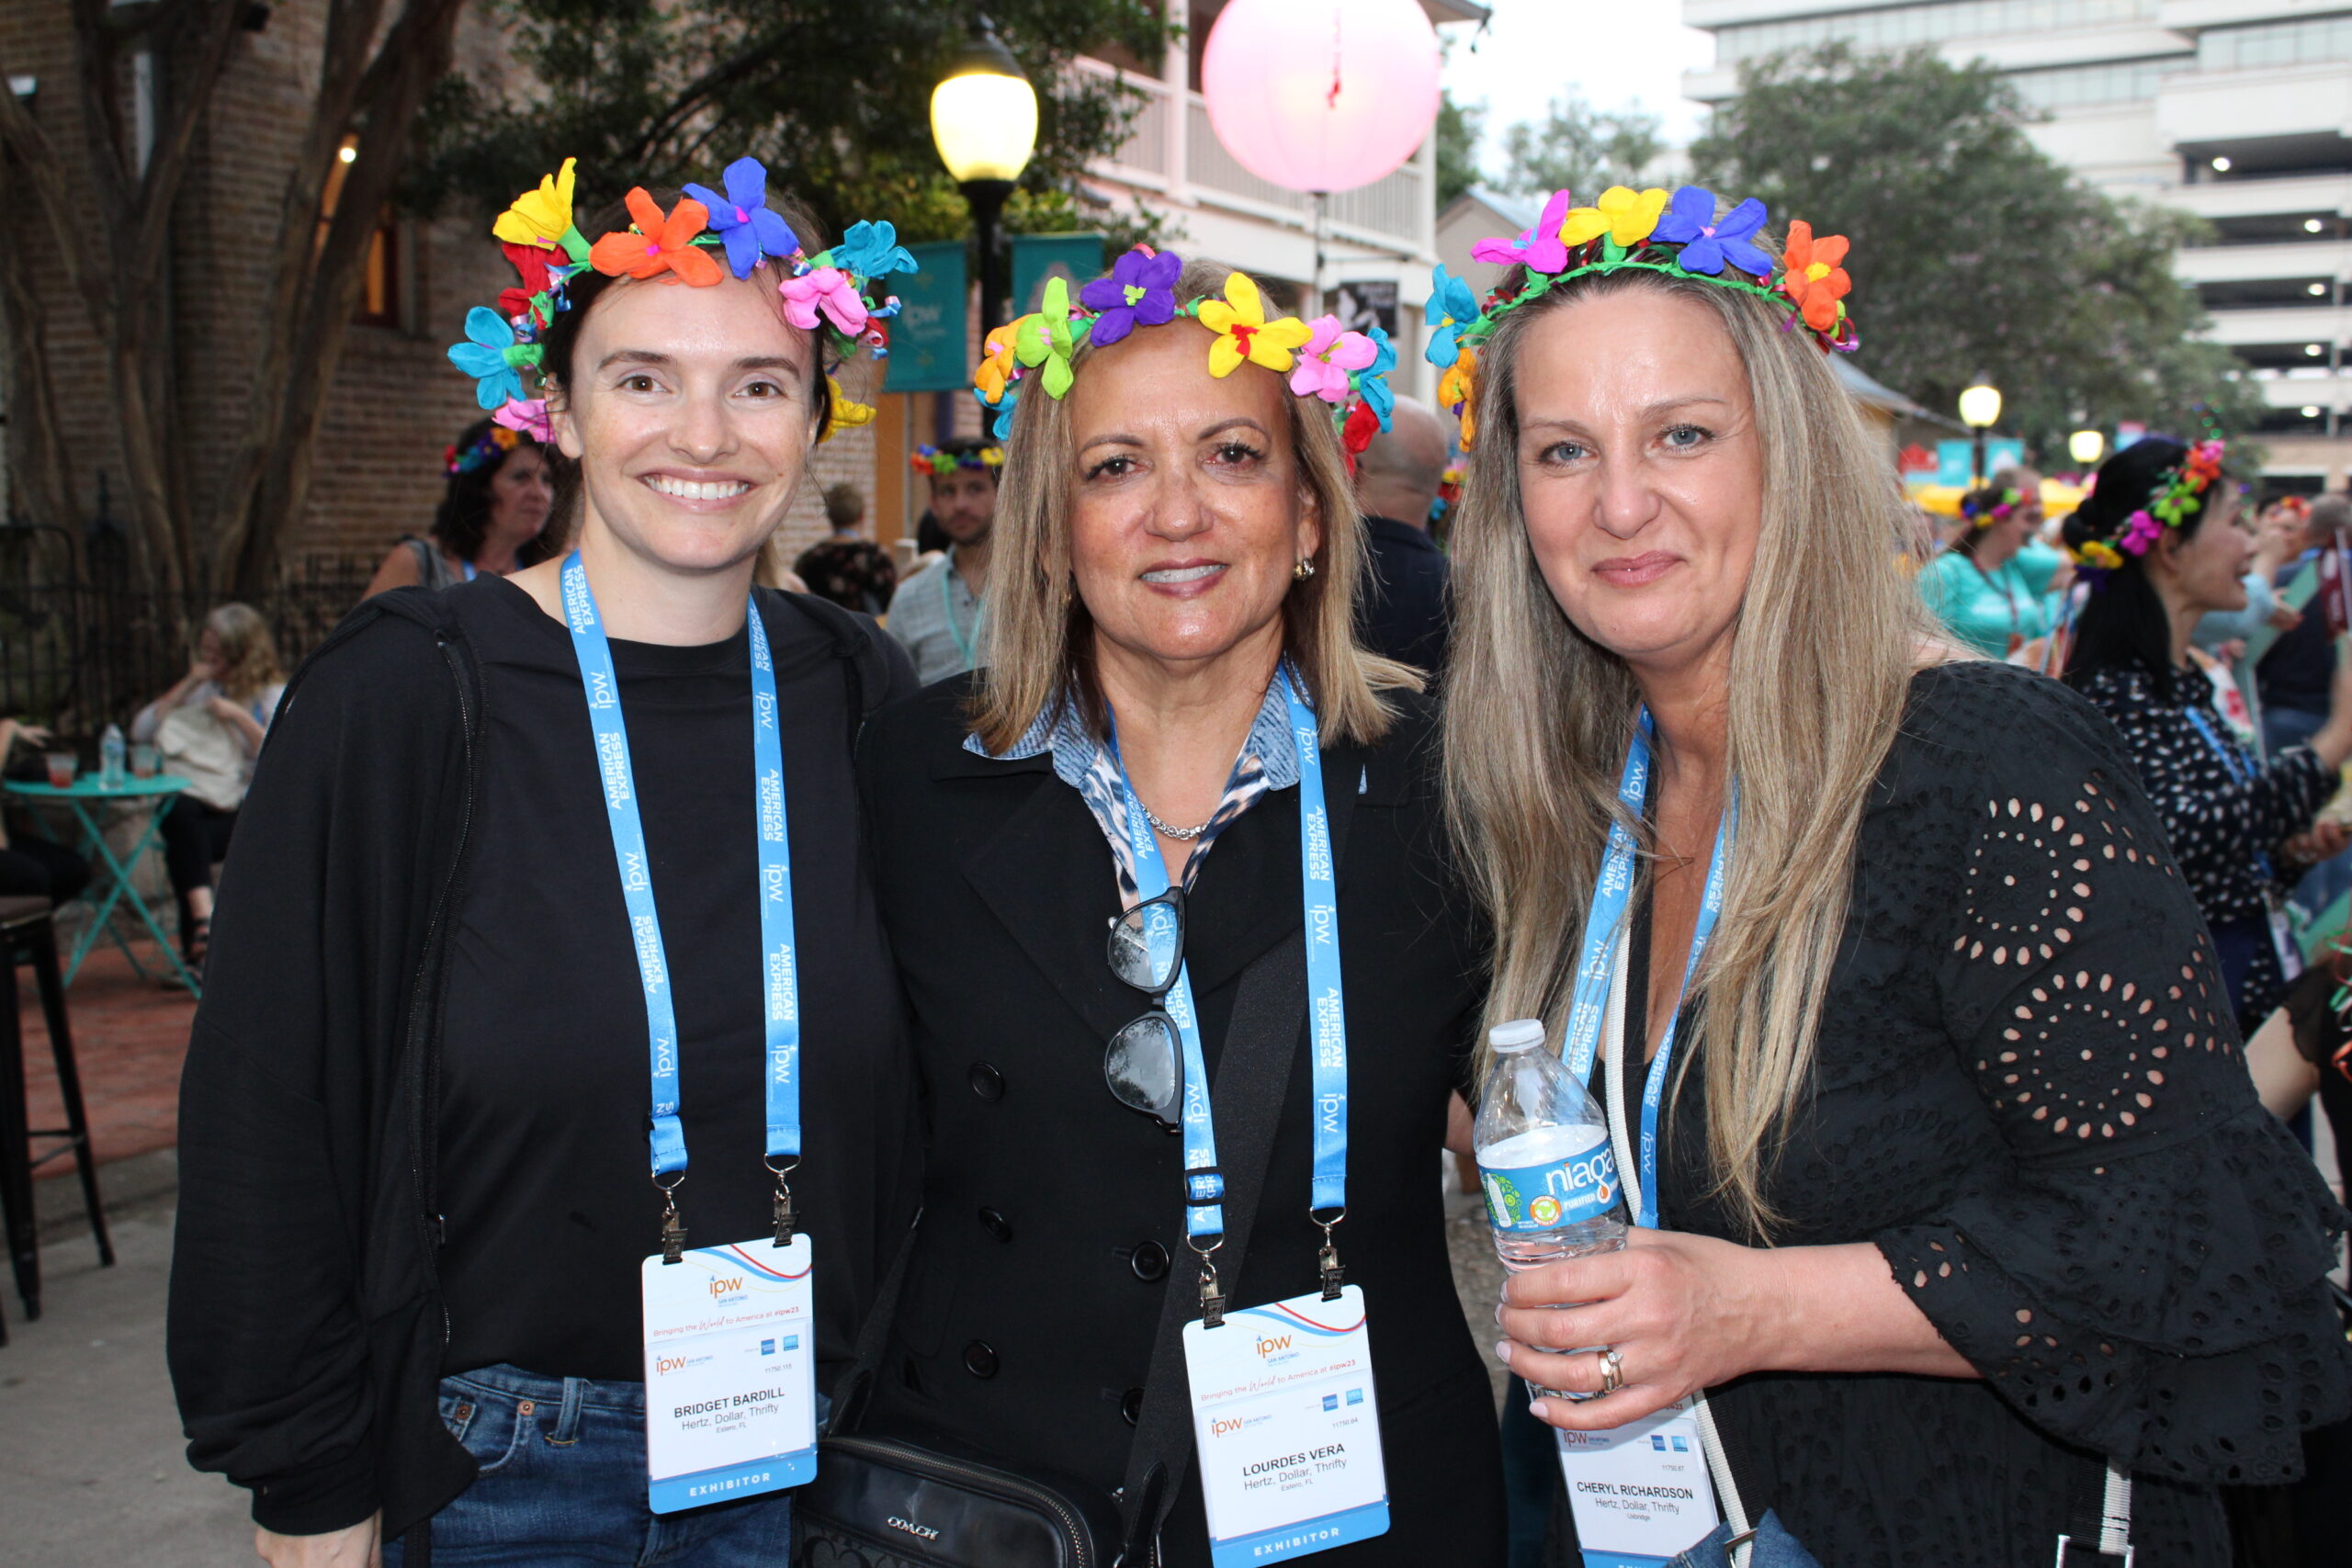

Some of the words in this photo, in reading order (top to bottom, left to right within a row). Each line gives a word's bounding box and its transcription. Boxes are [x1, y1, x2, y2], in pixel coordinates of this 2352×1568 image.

[564, 569, 586, 634] AMERICAN
[573, 565, 594, 626] EXPRESS
[750, 608, 763, 669] EXPRESS
[590, 671, 616, 709] ipw
[756, 692, 775, 728] ipw
[610, 732, 630, 799] EXPRESS
[1296, 727, 1317, 765] ipw
[599, 733, 622, 810] AMERICAN
[1623, 761, 1645, 801] ipw
[761, 777, 774, 841] EXPRESS
[769, 768, 784, 842] AMERICAN
[1125, 789, 1148, 859] AMERICAN
[1307, 813, 1320, 880] EXPRESS
[1315, 805, 1330, 881] AMERICAN
[625, 852, 649, 892] ipw
[763, 863, 788, 903] ipw
[1147, 904, 1173, 936] ipw
[1309, 905, 1336, 944] ipw
[634, 916, 657, 993] AMERICAN
[643, 915, 663, 984] EXPRESS
[1582, 940, 1609, 980] ipw
[770, 953, 783, 1021] EXPRESS
[780, 943, 795, 1021] AMERICAN
[1317, 998, 1331, 1067] EXPRESS
[1328, 987, 1342, 1067] AMERICAN
[1577, 1004, 1600, 1074] EXPRESS
[653, 1038, 675, 1077] ipw
[770, 1044, 797, 1084] ipw
[1186, 1083, 1207, 1122] ipw
[1318, 1093, 1346, 1133] ipw
[1642, 1132, 1654, 1174] ipw
[1564, 1192, 1596, 1210] PURIFIED
[709, 1275, 743, 1299] ipw
[653, 1325, 684, 1337] Bringing
[685, 1323, 697, 1331] the
[699, 1315, 726, 1331] World
[735, 1313, 764, 1324] America
[775, 1306, 799, 1316] #ipw23
[656, 1356, 686, 1376] ipw
[1256, 1335, 1292, 1359] ipw
[1201, 1388, 1233, 1401] Bringing
[1235, 1384, 1247, 1393] the
[1250, 1375, 1275, 1392] World
[1288, 1370, 1317, 1382] America
[1329, 1359, 1356, 1372] #ipw23
[674, 1398, 729, 1418] BRIDGET
[733, 1387, 785, 1406] BARDILL
[749, 1404, 779, 1417] Thrifty
[1211, 1417, 1242, 1438] ipw
[1564, 1431, 1588, 1447] ipw
[1243, 1452, 1306, 1476] LOURDES
[1309, 1443, 1345, 1461] VERA
[1315, 1459, 1347, 1473] Thrifty
[690, 1472, 771, 1496] EXHIBITOR
[1577, 1482, 1619, 1495] CHERYL
[1621, 1484, 1693, 1500] RICHARDSON
[1595, 1498, 1621, 1510] Hertz,
[1623, 1500, 1649, 1512] Dollar,
[1651, 1502, 1679, 1515] Thrifty
[888, 1516, 940, 1540] COACH
[1253, 1528, 1340, 1556] EXHIBITOR
